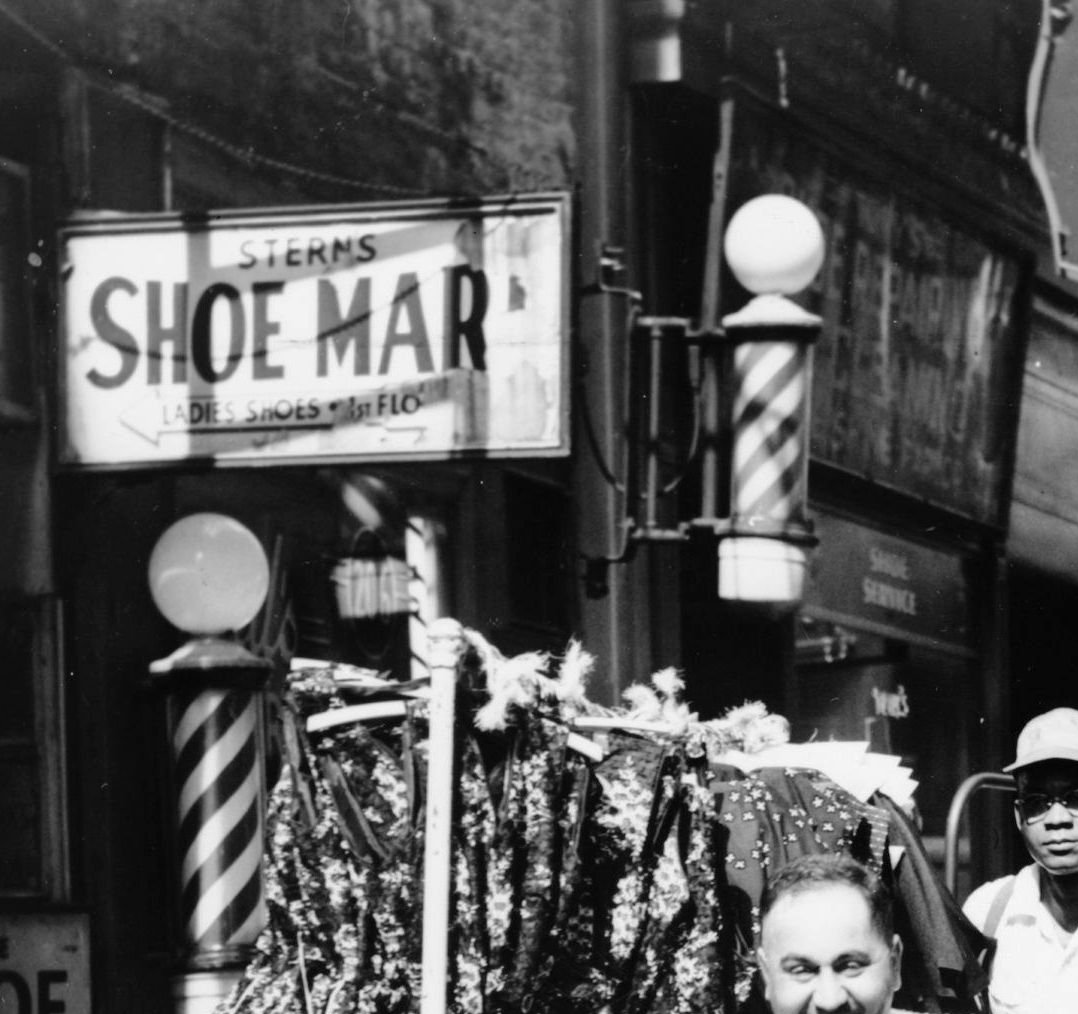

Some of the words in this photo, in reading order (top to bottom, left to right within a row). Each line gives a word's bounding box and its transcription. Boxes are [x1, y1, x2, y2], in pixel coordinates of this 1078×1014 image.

[86, 276, 285, 389] SHOE
[317, 264, 525, 378] MAR
[163, 402, 234, 424] LADIES
[246, 398, 319, 422] SHOES
